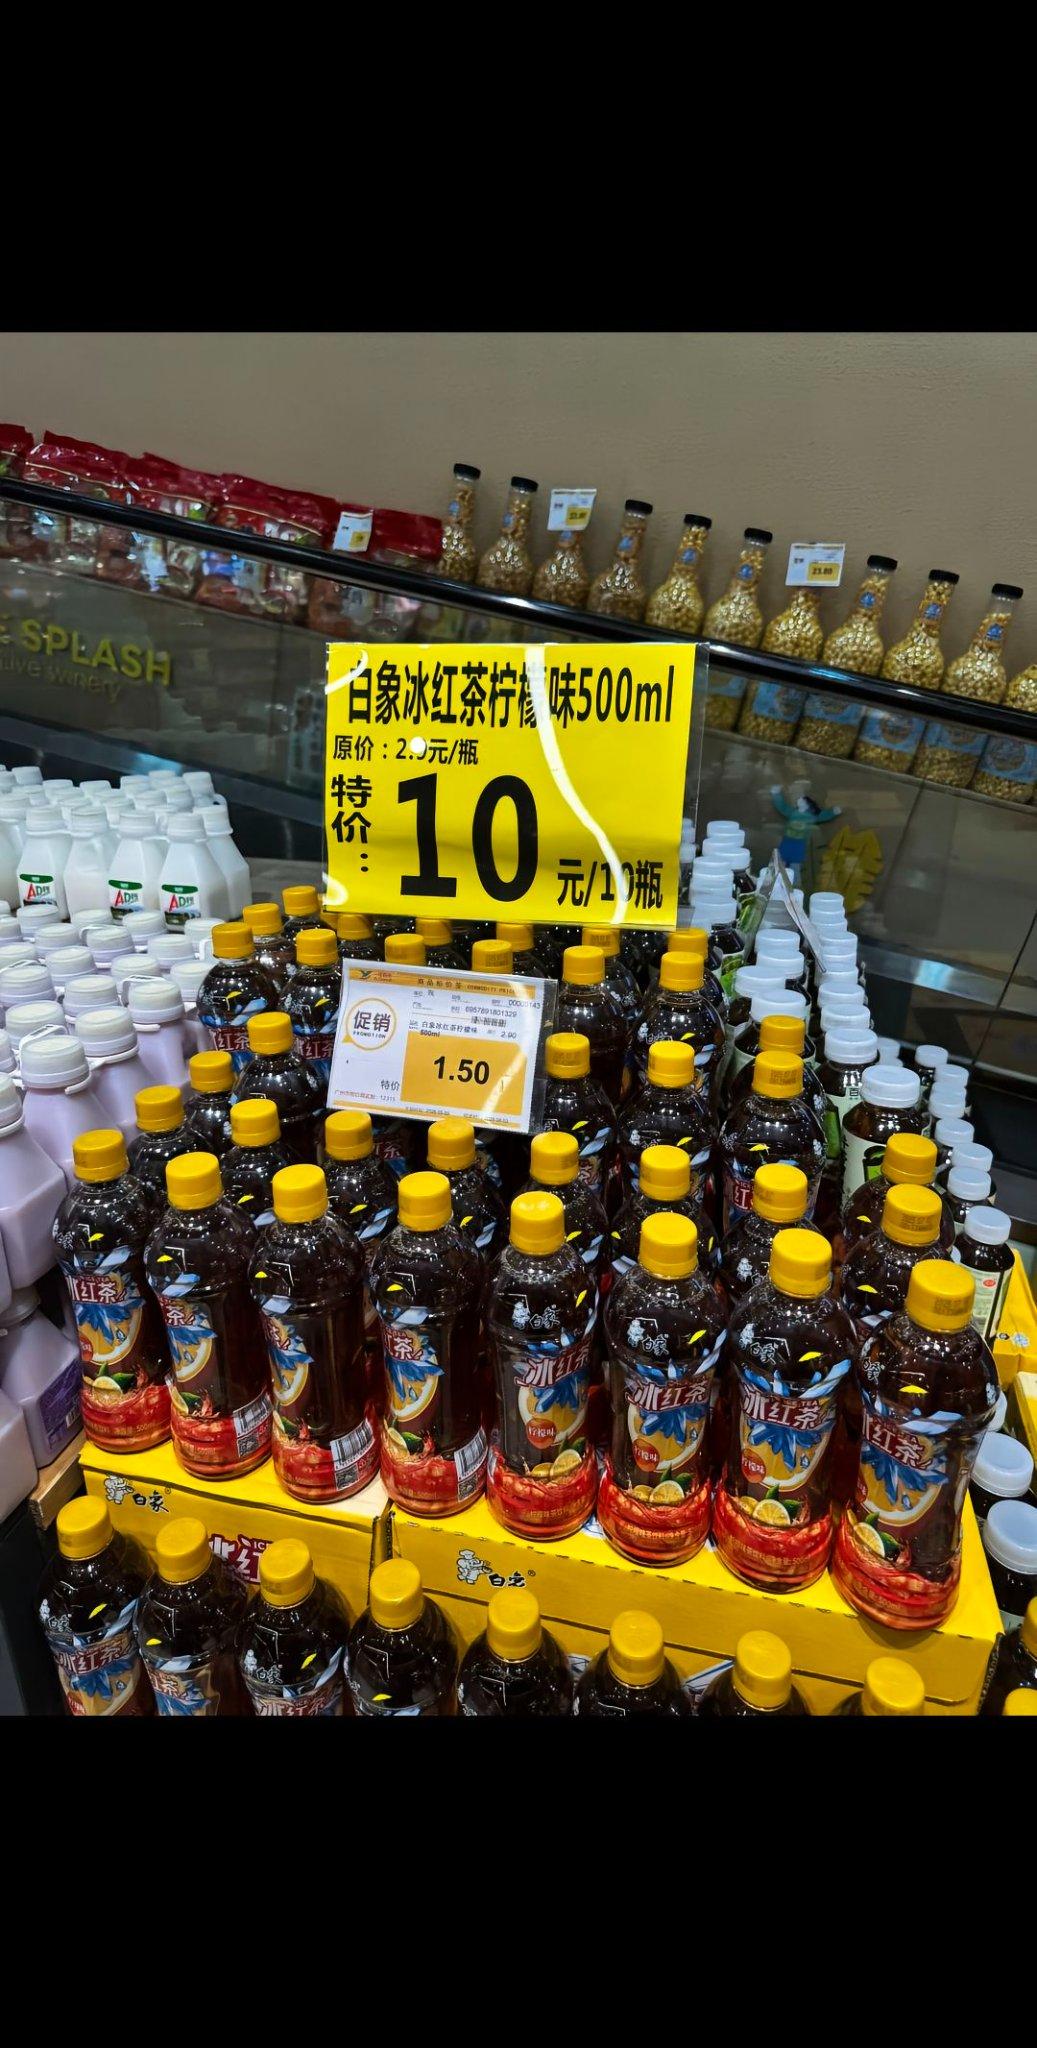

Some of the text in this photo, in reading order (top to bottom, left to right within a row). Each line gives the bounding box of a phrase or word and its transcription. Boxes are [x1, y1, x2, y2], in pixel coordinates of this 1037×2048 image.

[22, 619, 170, 686] SPLASH
[398, 773, 663, 909] 10 元/10瓶
[354, 1011, 391, 1032] 促销
[353, 1031, 387, 1039] PROMOTION
[434, 1055, 490, 1085] 1.50
[380, 1079, 400, 1091] 特价
[625, 1381, 706, 1412] 冰红茶
[254, 1542, 268, 1550] IC
